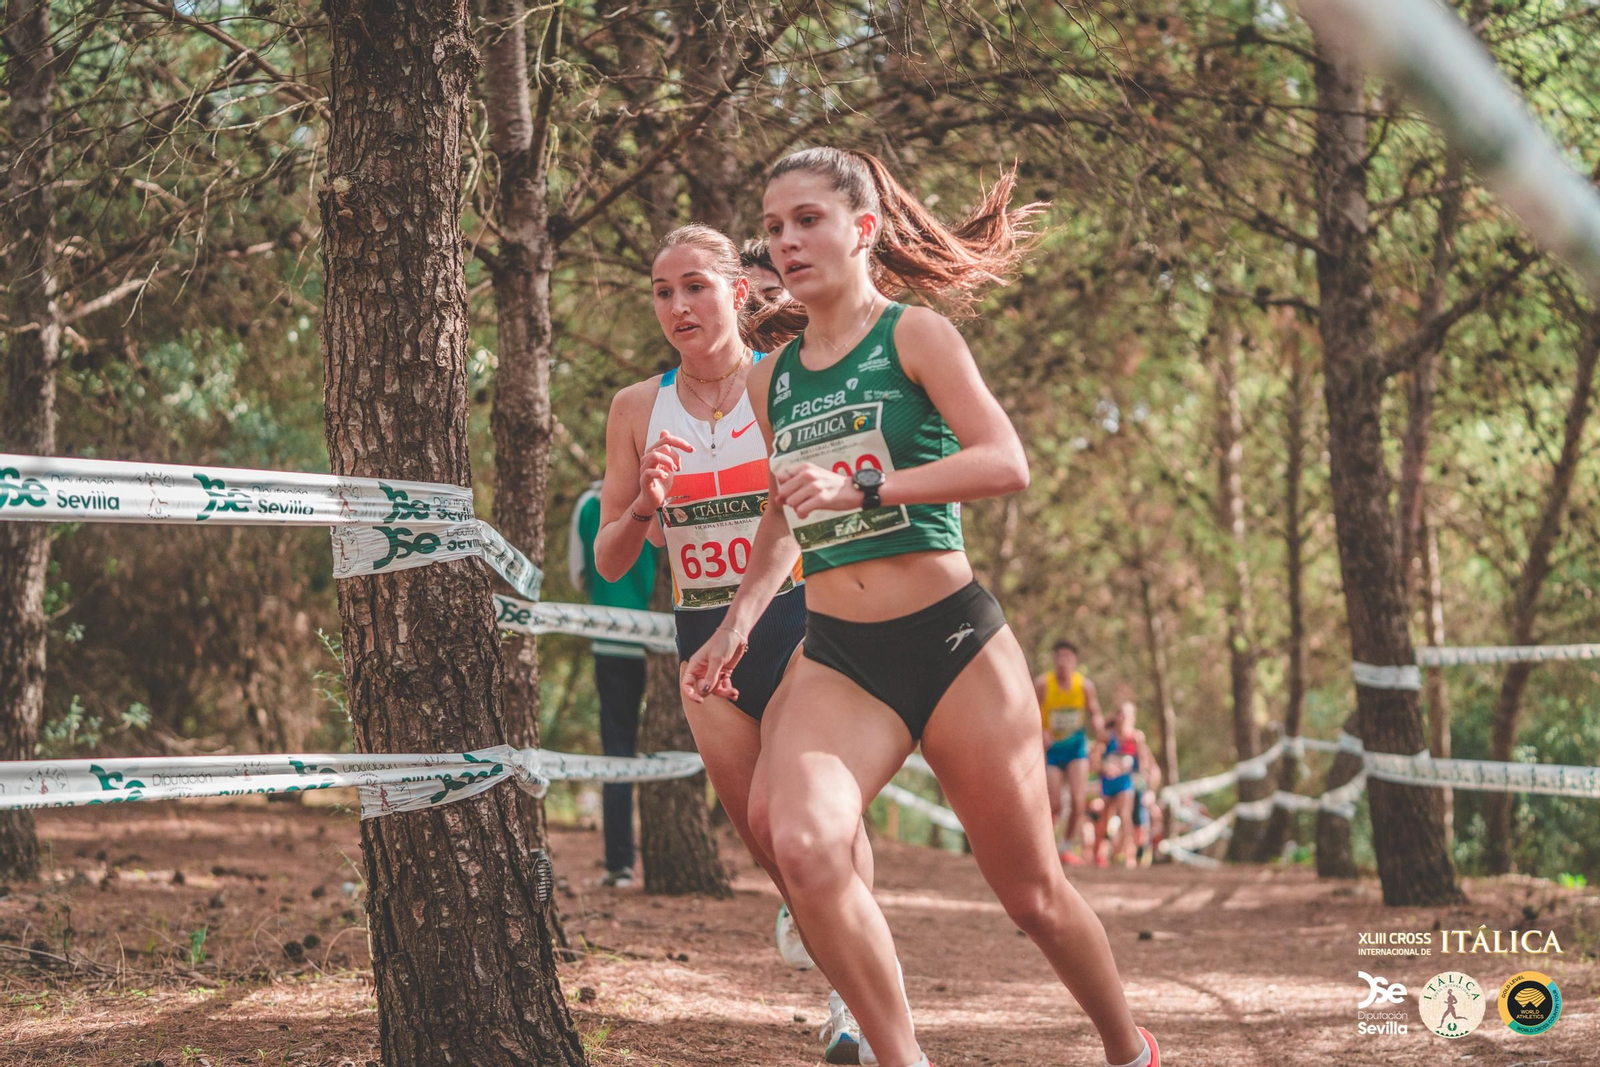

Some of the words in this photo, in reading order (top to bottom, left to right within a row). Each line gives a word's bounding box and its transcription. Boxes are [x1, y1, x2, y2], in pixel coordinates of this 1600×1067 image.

[797, 416, 847, 442] ITÁLICA
[56, 490, 120, 510] Sevilla
[257, 500, 314, 516] Sevilla
[692, 499, 752, 517] ITÁLICA
[680, 537, 752, 579] 630
